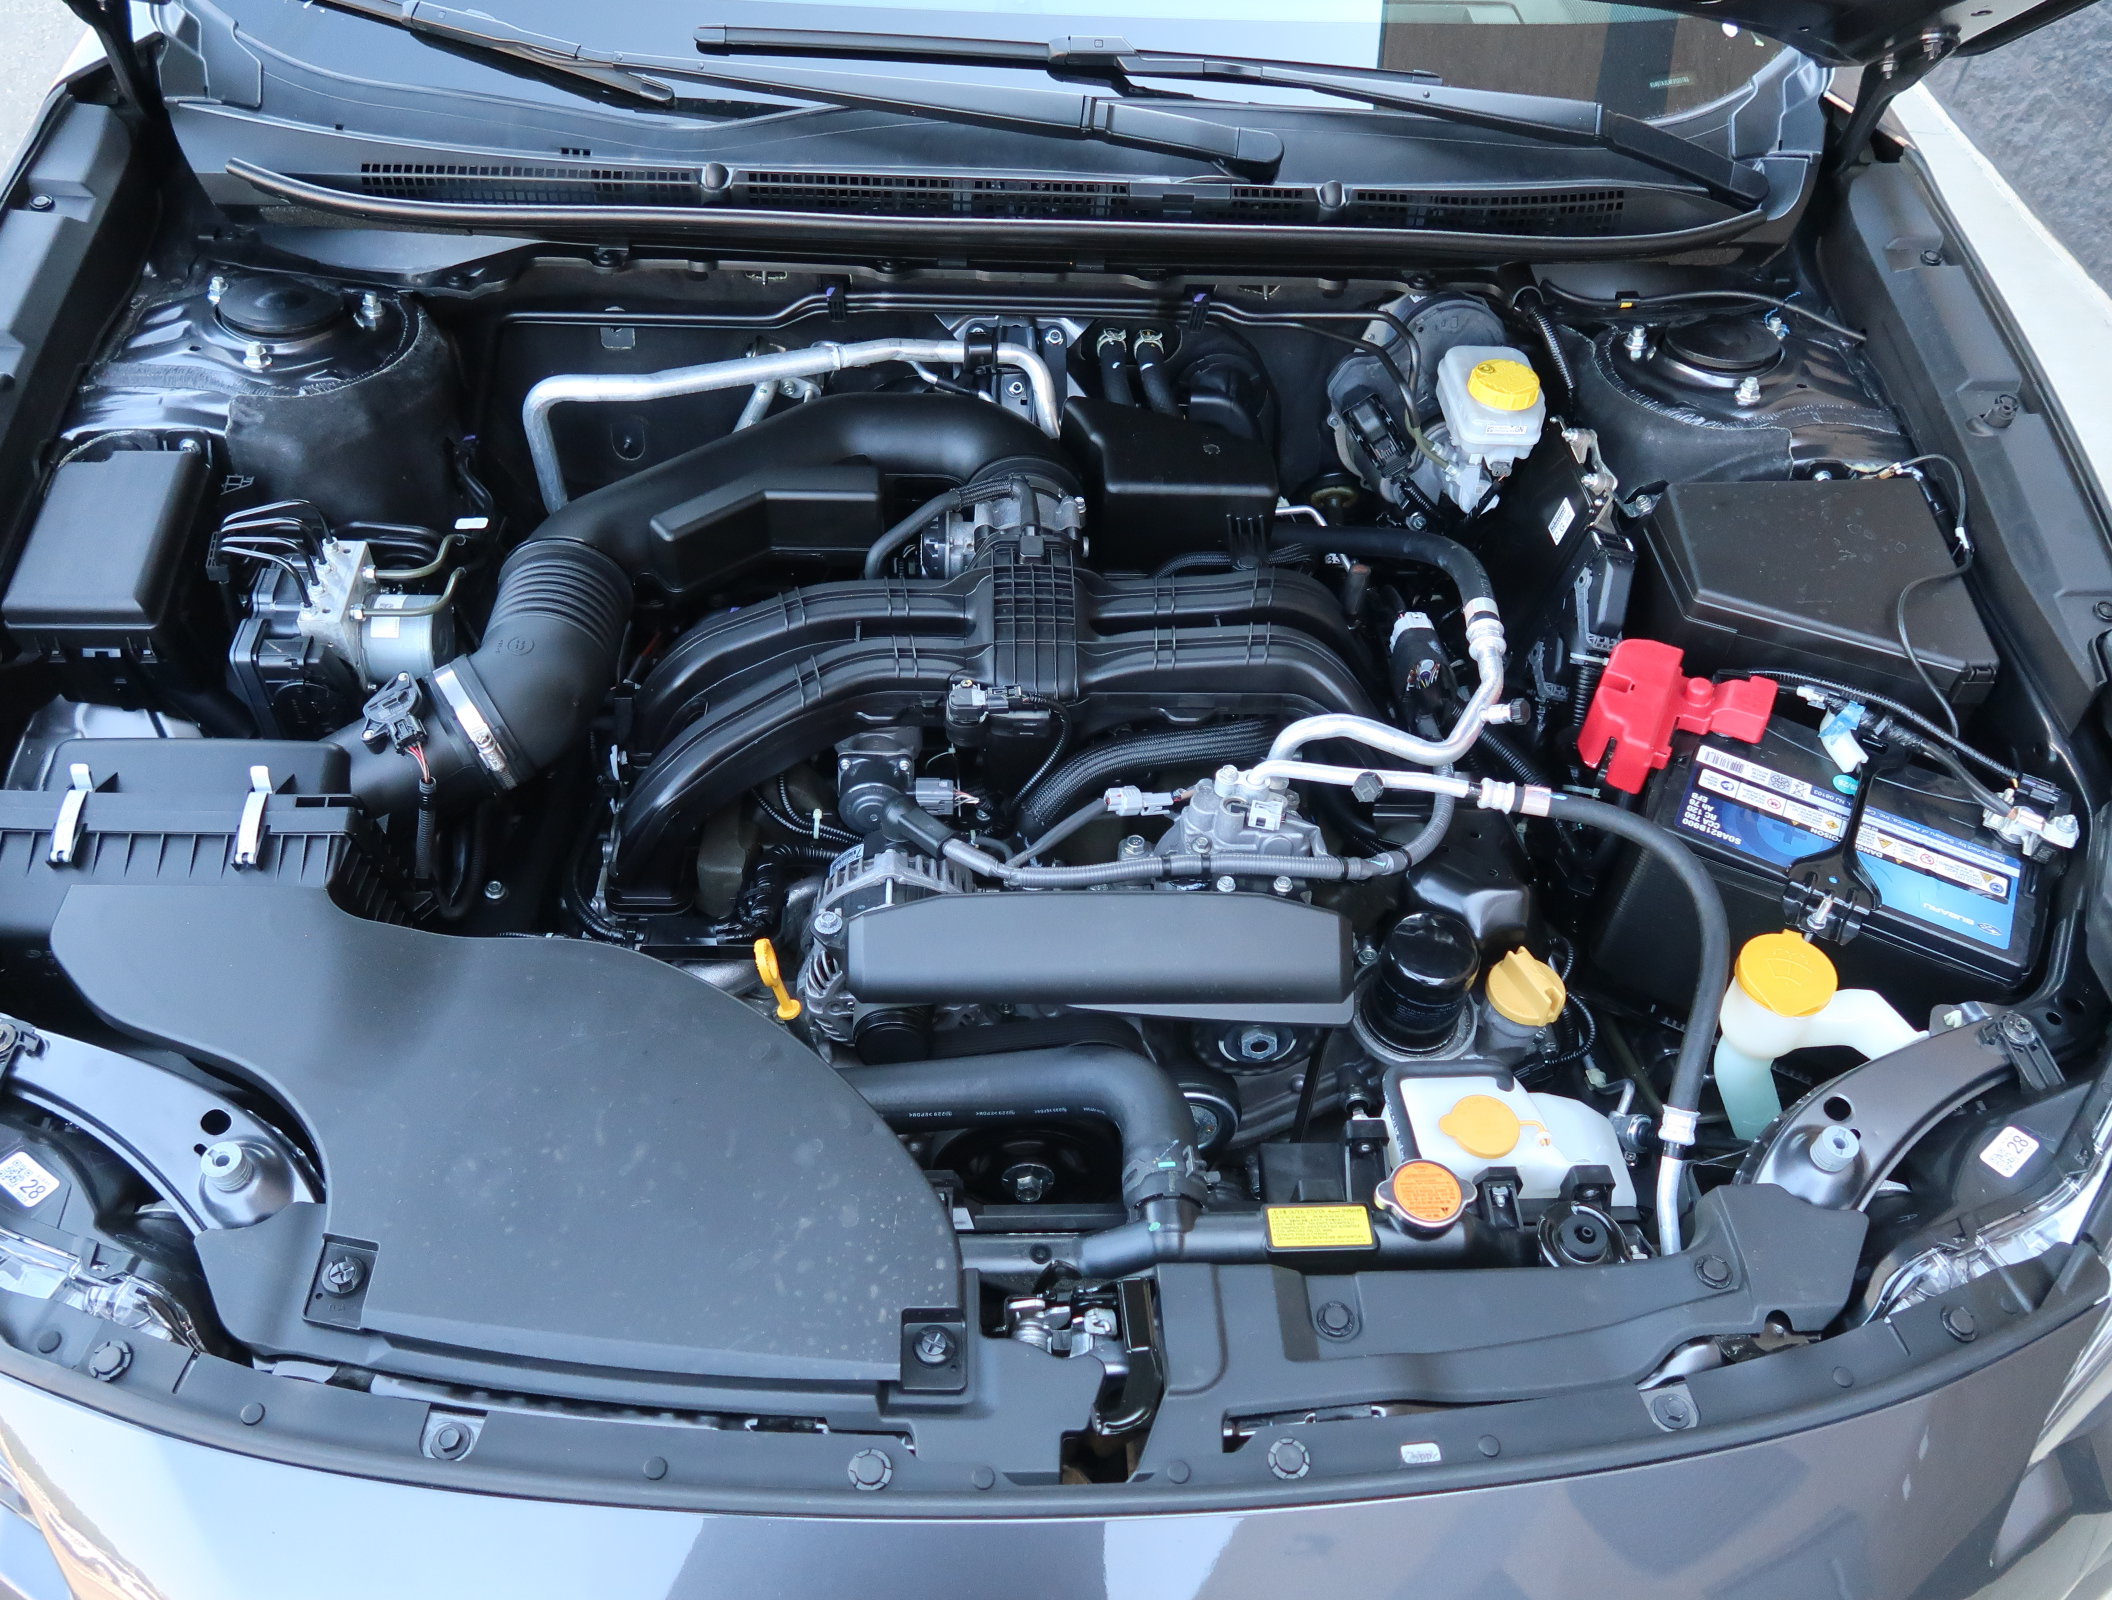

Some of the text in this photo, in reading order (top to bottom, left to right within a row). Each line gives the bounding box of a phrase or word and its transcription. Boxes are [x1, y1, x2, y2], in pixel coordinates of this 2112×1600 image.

[1691, 792, 1708, 803] EFB
[1686, 805, 1718, 821] RC 120
[1701, 803, 1715, 812] Ah
[1684, 811, 1721, 829] CCA 750
[1809, 827, 1842, 842] OISON
[1931, 832, 1955, 844] Subaru
[1967, 845, 2006, 862] Distributed
[1923, 902, 1975, 925] SUBARU
[2007, 1135, 2029, 1154] 28
[19, 1178, 46, 1199] 28
